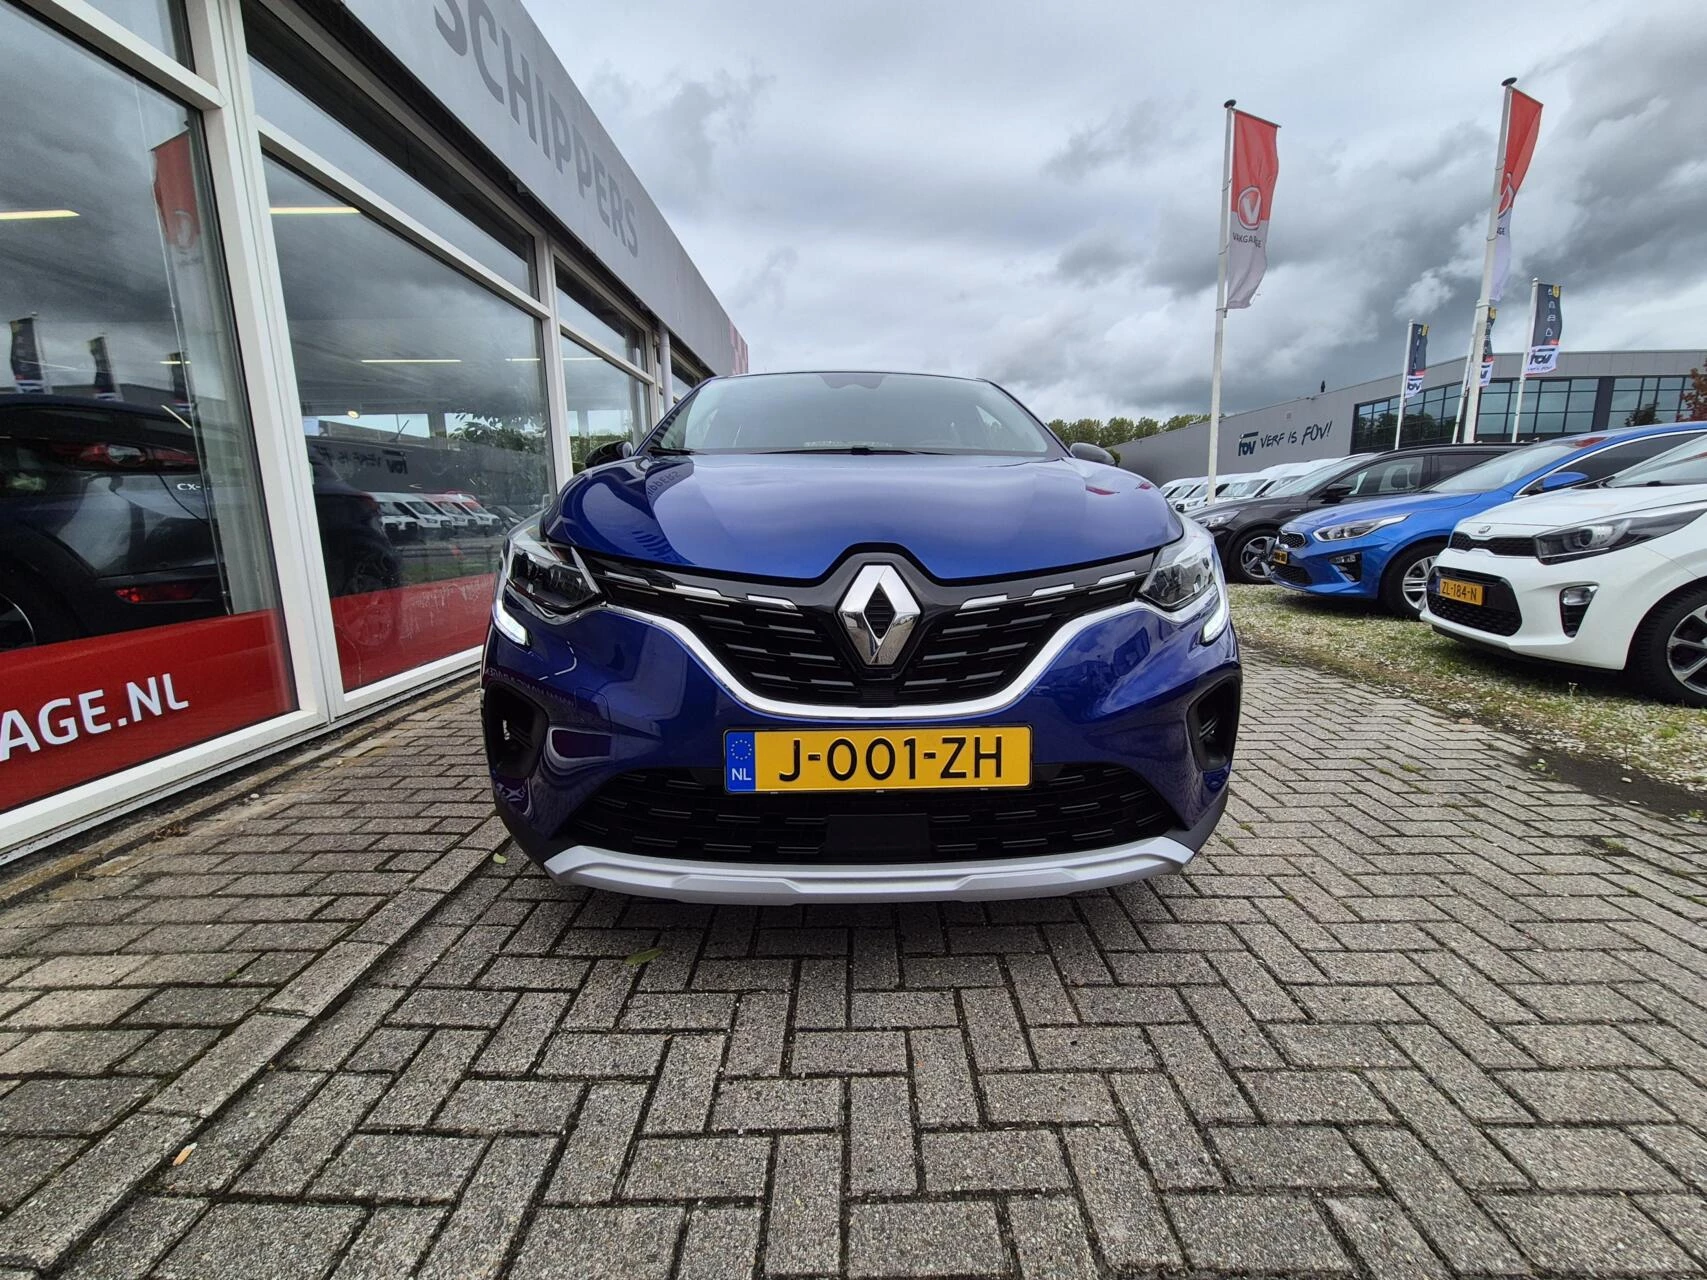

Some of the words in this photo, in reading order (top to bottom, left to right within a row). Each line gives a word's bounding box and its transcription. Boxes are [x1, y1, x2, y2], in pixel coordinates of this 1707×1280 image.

[1260, 432, 1285, 448] VERF
[1288, 431, 1297, 444] IS
[1301, 420, 1333, 446] FOV!
[177, 483, 210, 491] CX-
[1442, 581, 1477, 601] ZL-184-N
[0, 673, 190, 762] AGE.NL
[731, 768, 752, 781] NL
[779, 735, 1003, 783] J-001-ZH
